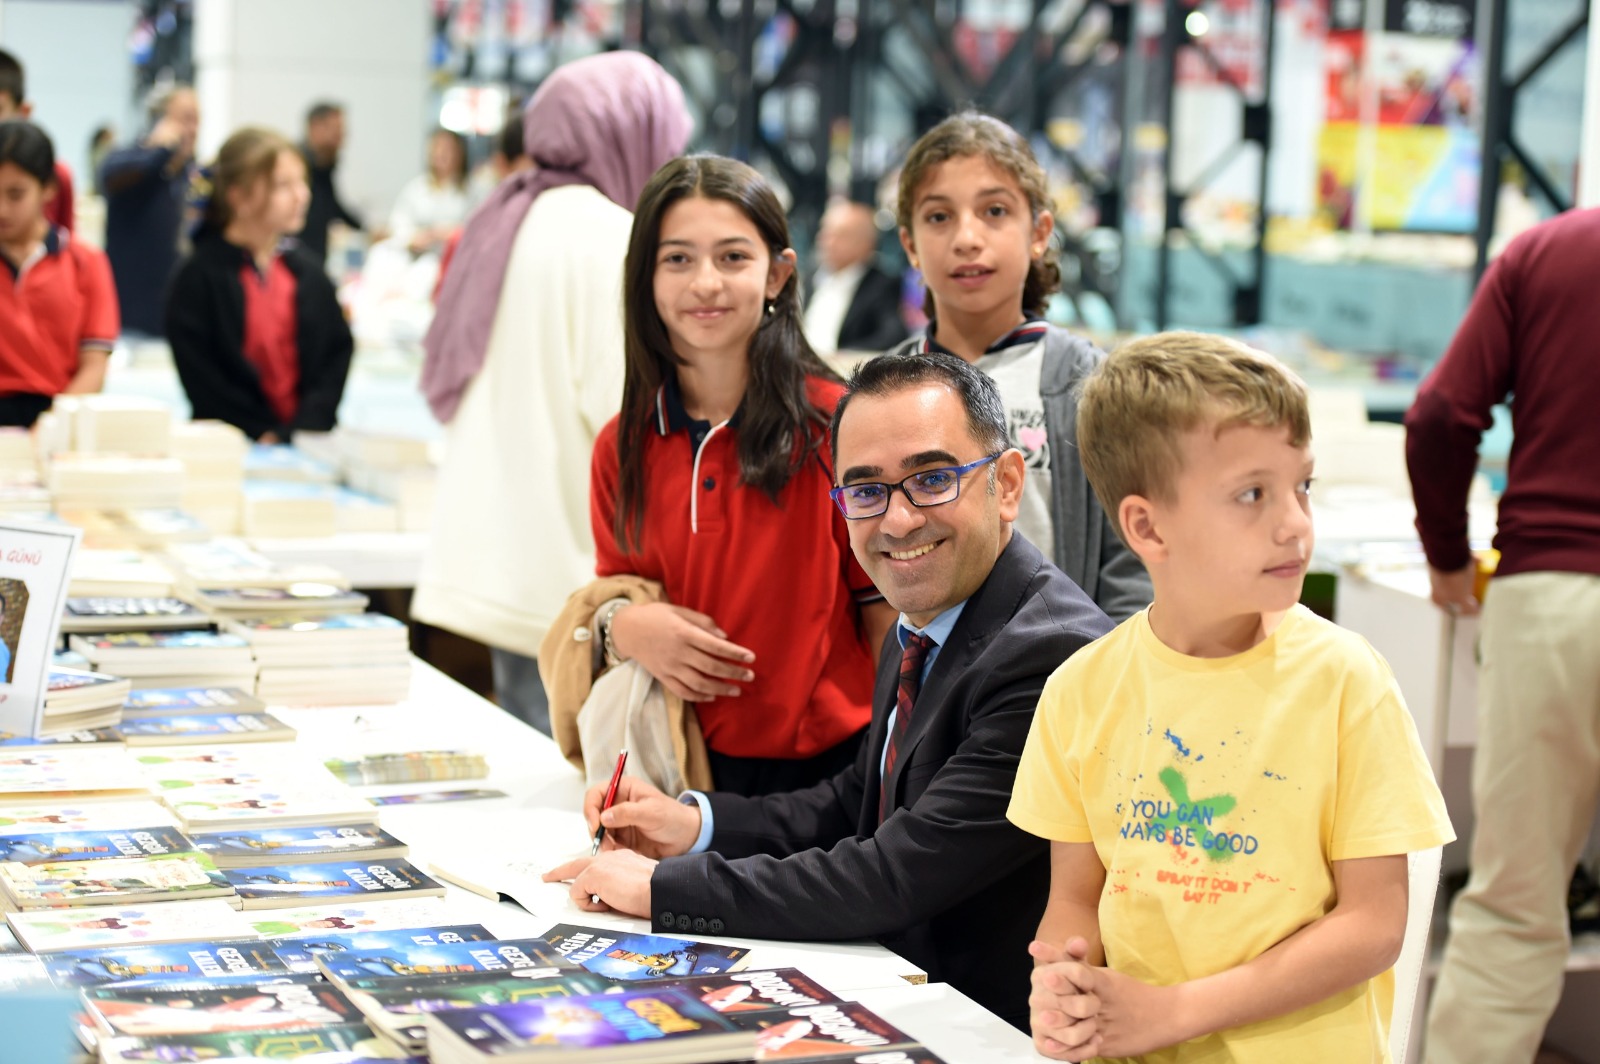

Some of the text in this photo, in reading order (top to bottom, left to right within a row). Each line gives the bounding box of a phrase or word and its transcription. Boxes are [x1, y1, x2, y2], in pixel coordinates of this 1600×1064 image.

[1131, 799, 1214, 826] YOU CAN
[1173, 826, 1197, 847] BE
[1202, 830, 1258, 855] GOOD
[1195, 876, 1209, 889] IT
[1208, 891, 1222, 904] IT
